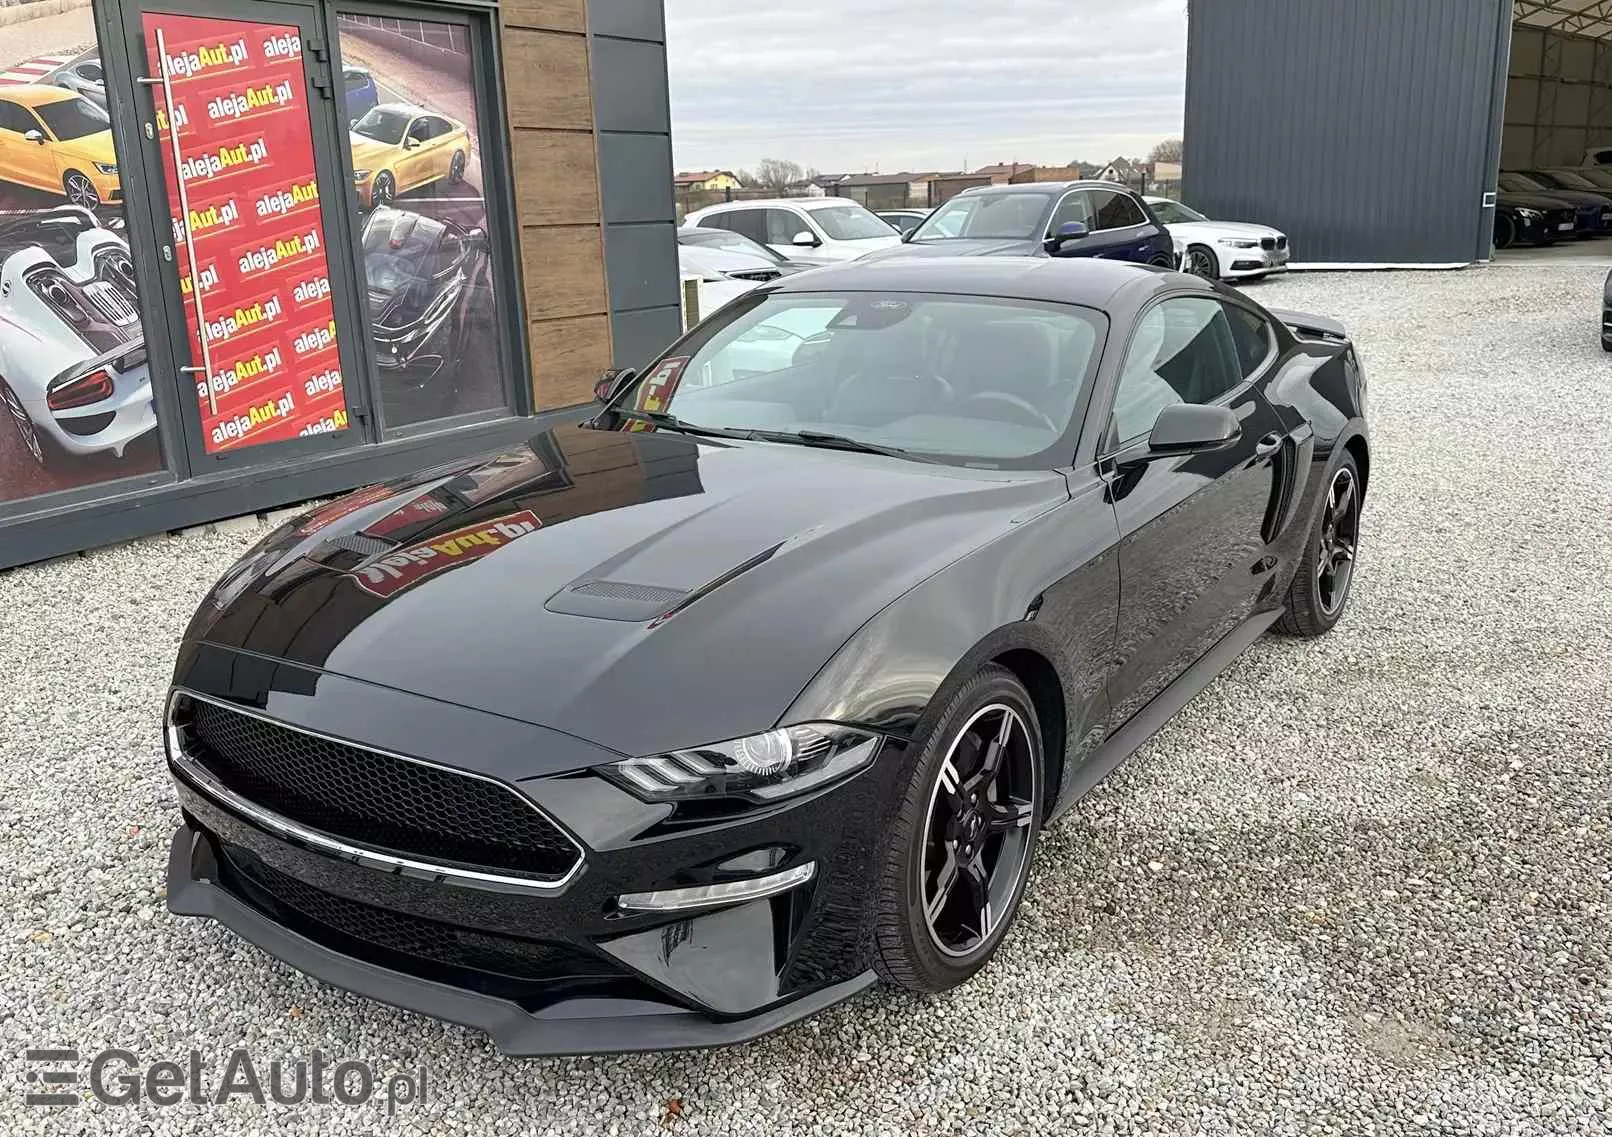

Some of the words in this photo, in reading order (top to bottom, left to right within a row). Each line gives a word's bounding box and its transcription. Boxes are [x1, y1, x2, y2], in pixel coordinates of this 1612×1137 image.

[157, 39, 248, 77] lejaAut.pl
[207, 80, 292, 120] alejaAut.pl
[181, 138, 268, 180] alejaAut.pl
[239, 229, 320, 273] alejaAut.pl
[293, 276, 330, 302] aleja
[197, 296, 282, 343] lejaAut.pl
[197, 348, 282, 398] aejaAut.pl
[211, 392, 294, 443] alejaAut.pl
